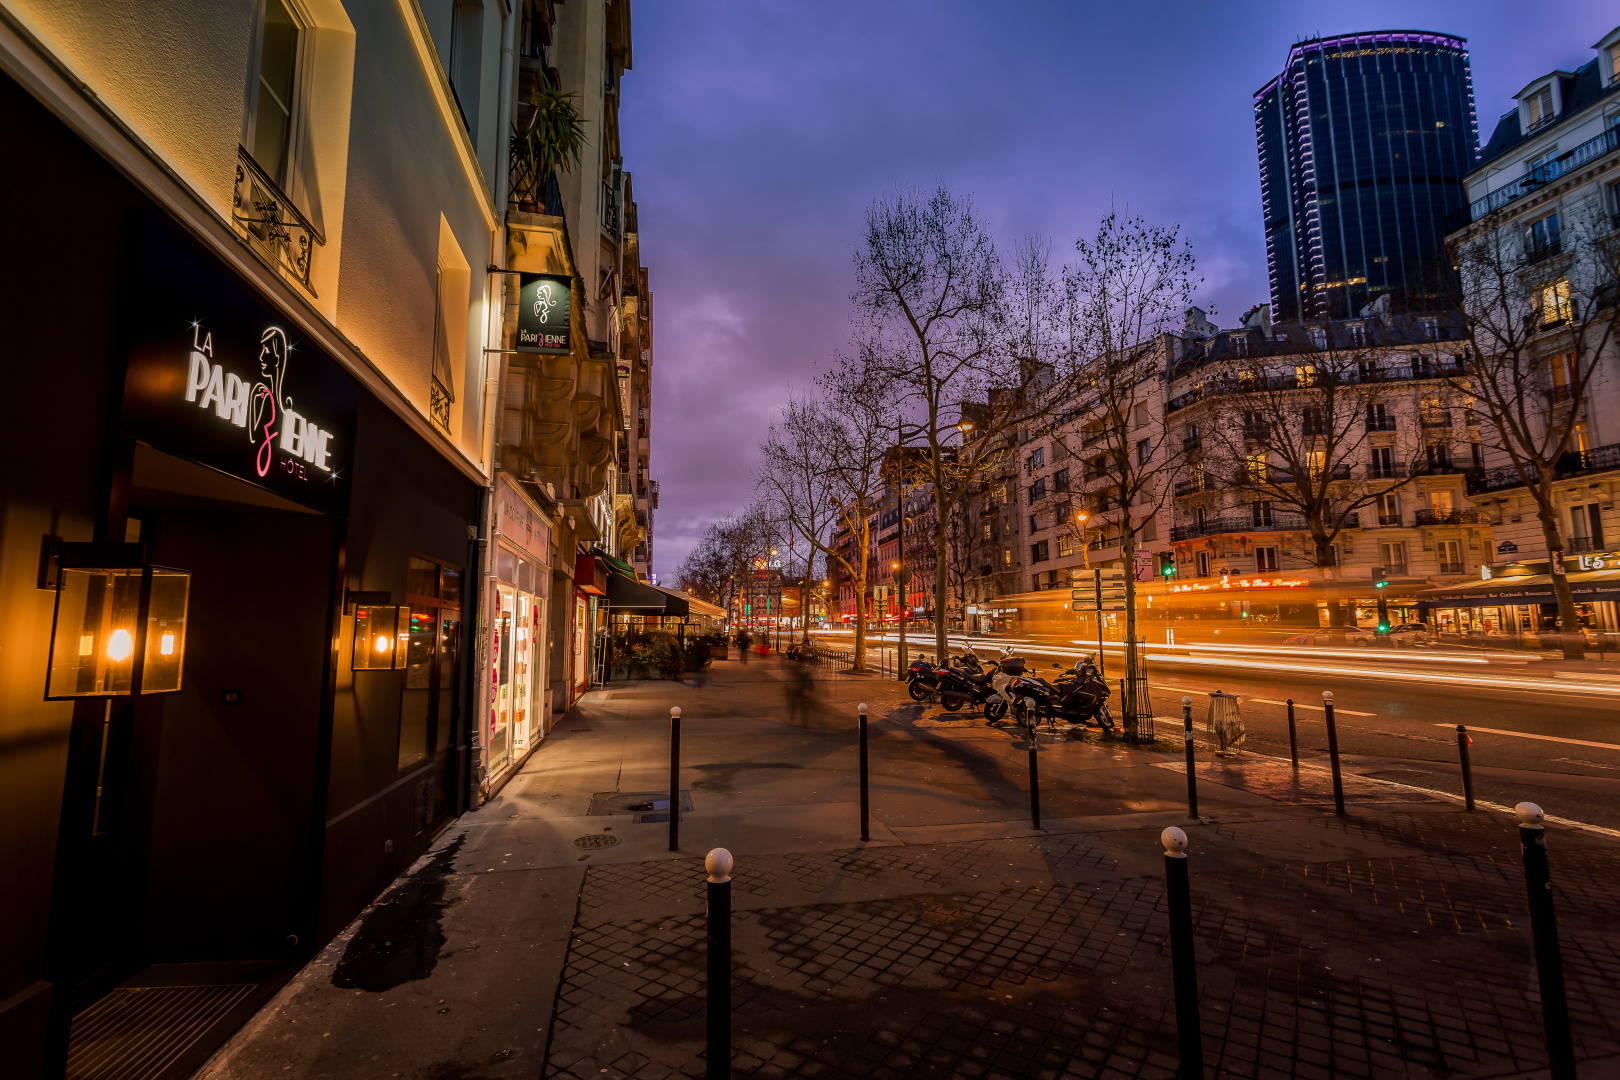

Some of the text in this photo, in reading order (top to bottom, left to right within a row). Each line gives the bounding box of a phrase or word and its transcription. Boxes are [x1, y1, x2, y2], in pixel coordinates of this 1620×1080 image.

[194, 324, 213, 358] LA
[280, 456, 308, 481] HÔTEL
[1579, 555, 1605, 571] LES
